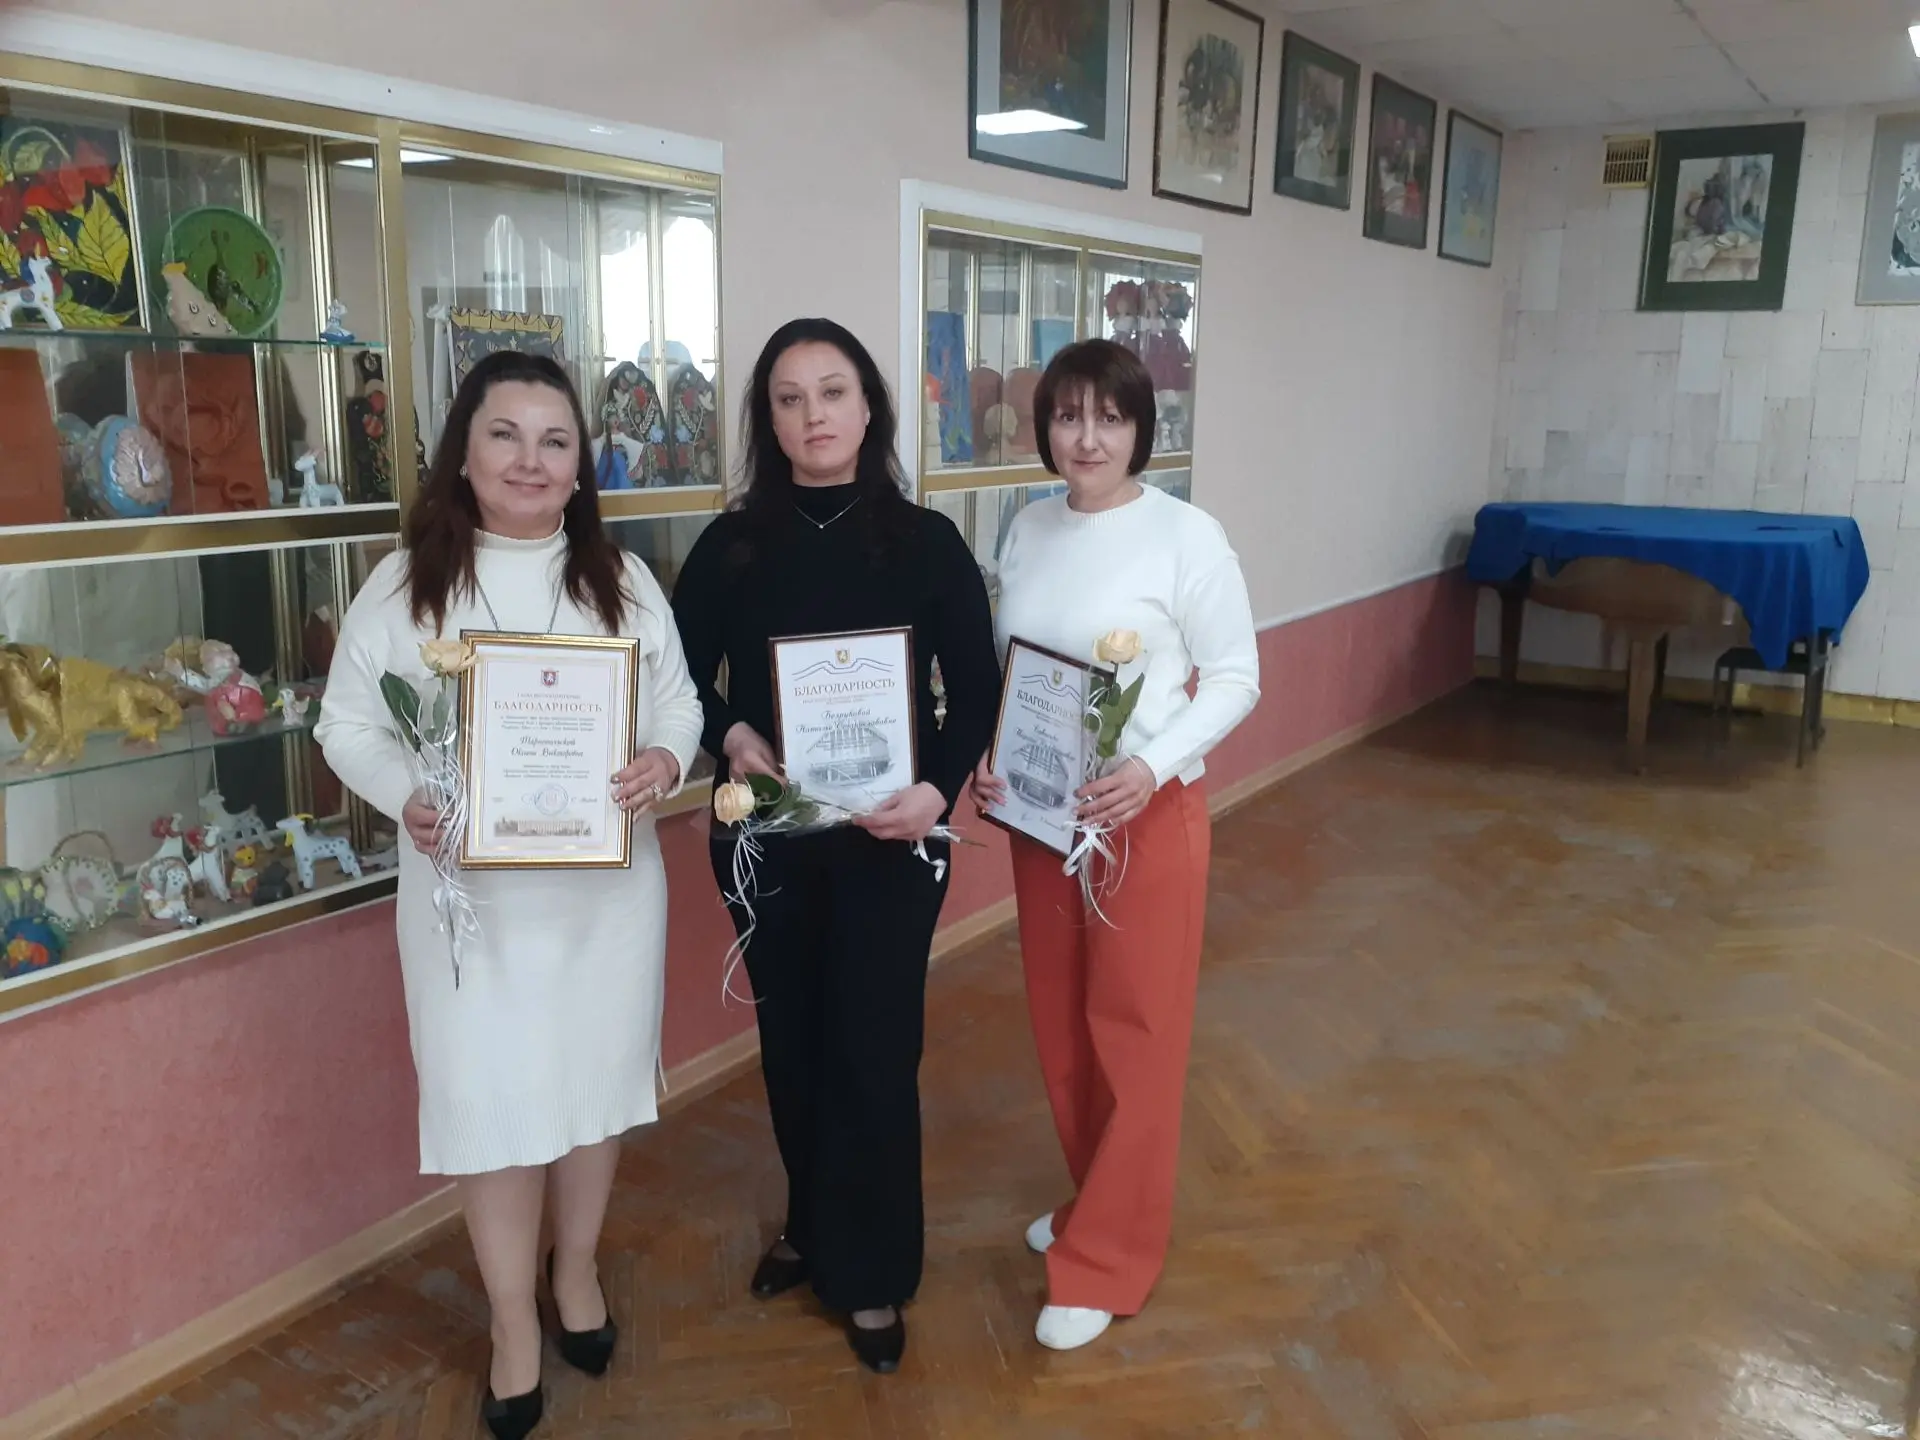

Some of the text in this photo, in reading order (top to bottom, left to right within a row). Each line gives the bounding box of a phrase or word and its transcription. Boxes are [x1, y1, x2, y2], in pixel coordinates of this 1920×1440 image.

[793, 678, 895, 697] БЛАГОДАРНОСТЬ
[493, 700, 602, 713] БЛАГОДАРНОСТЬ
[1016, 689, 1080, 720] БЛАГОДАРНО
